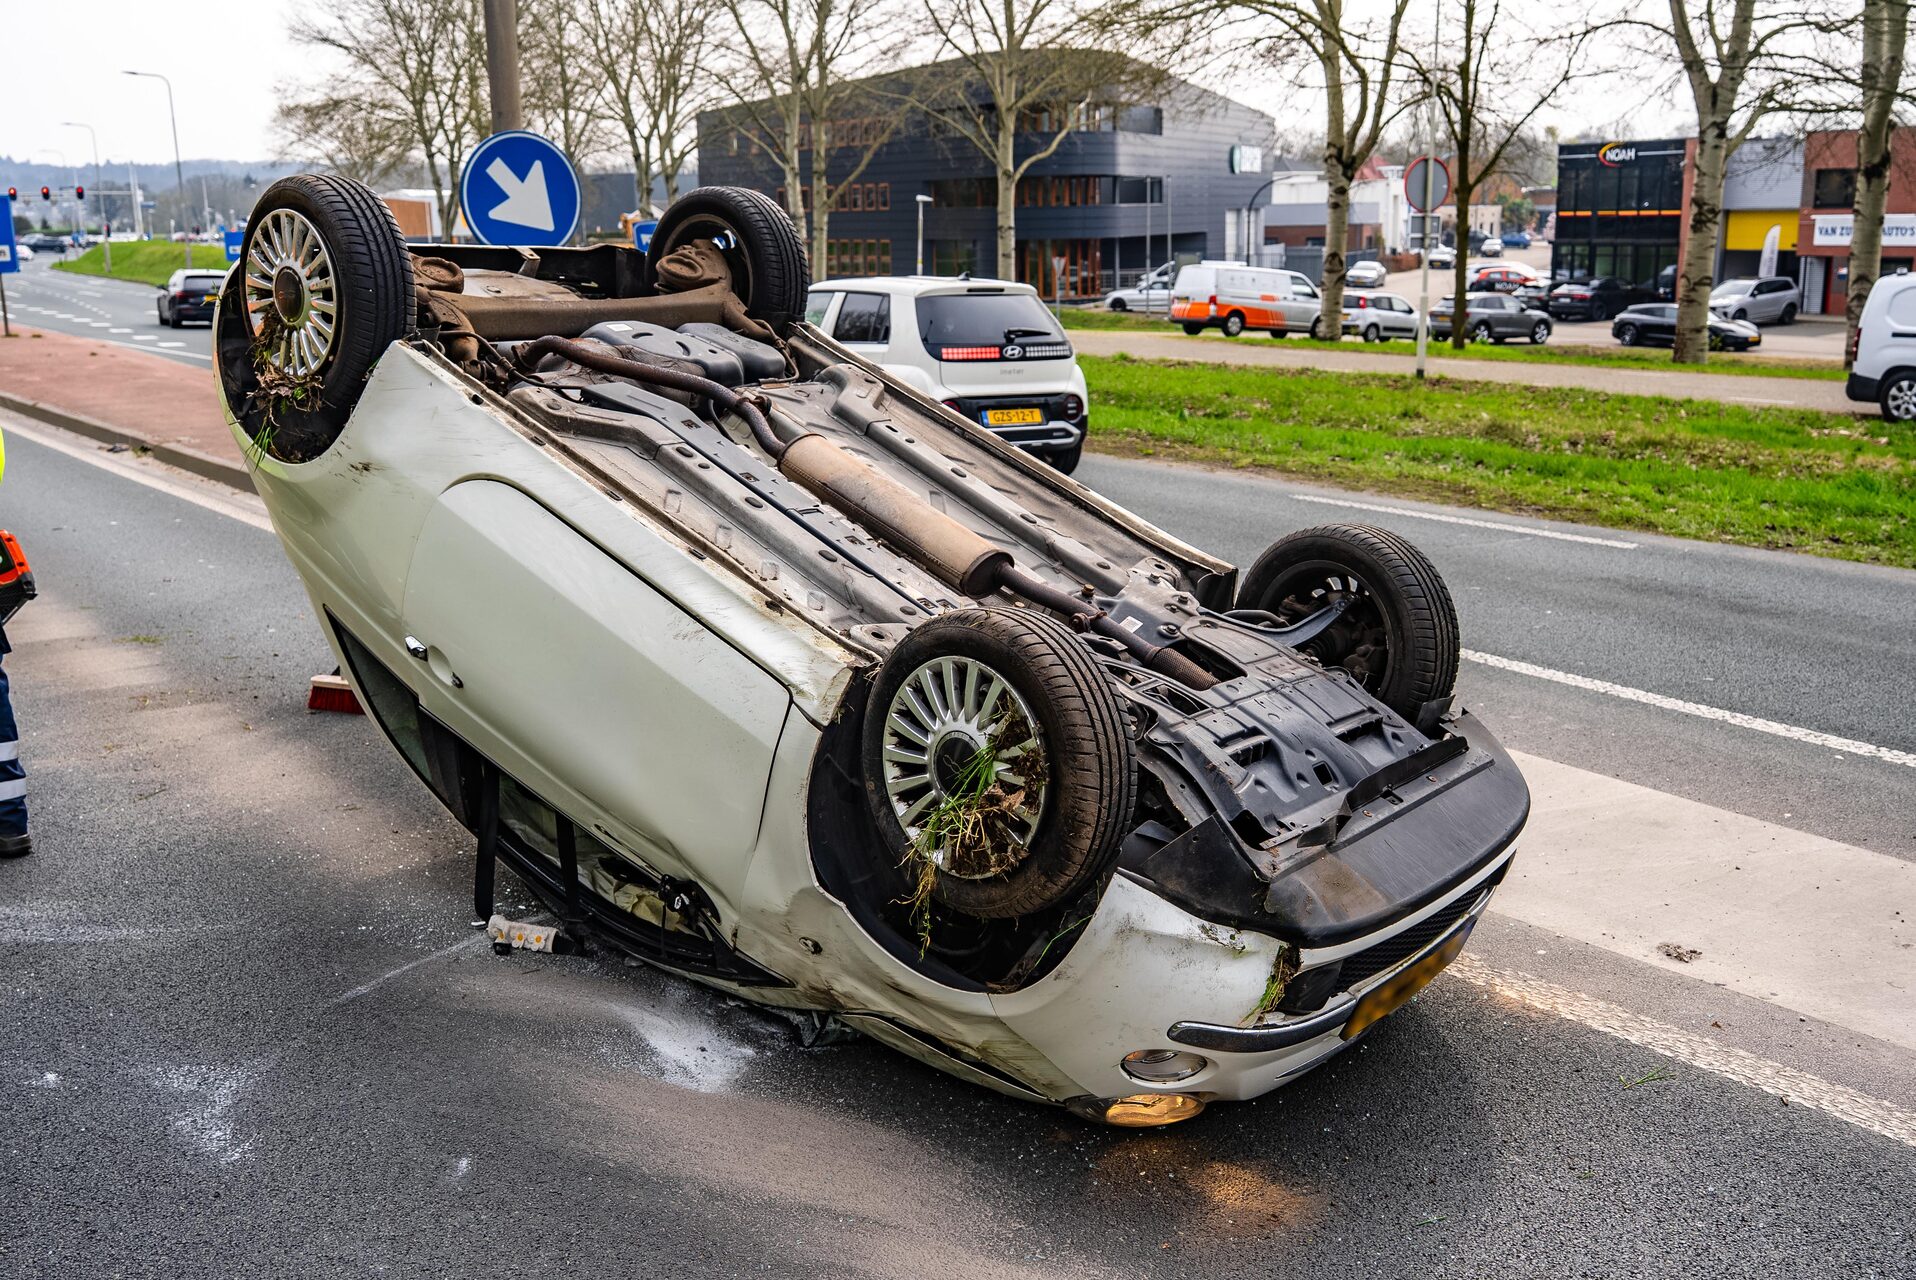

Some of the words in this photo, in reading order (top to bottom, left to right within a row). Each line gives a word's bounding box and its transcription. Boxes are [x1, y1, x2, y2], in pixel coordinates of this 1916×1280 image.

[1605, 147, 1636, 161] NOAH
[1818, 226, 1838, 236] VAN
[1881, 226, 1915, 236] AUTO'S
[993, 410, 1035, 422] GZS-12-T
